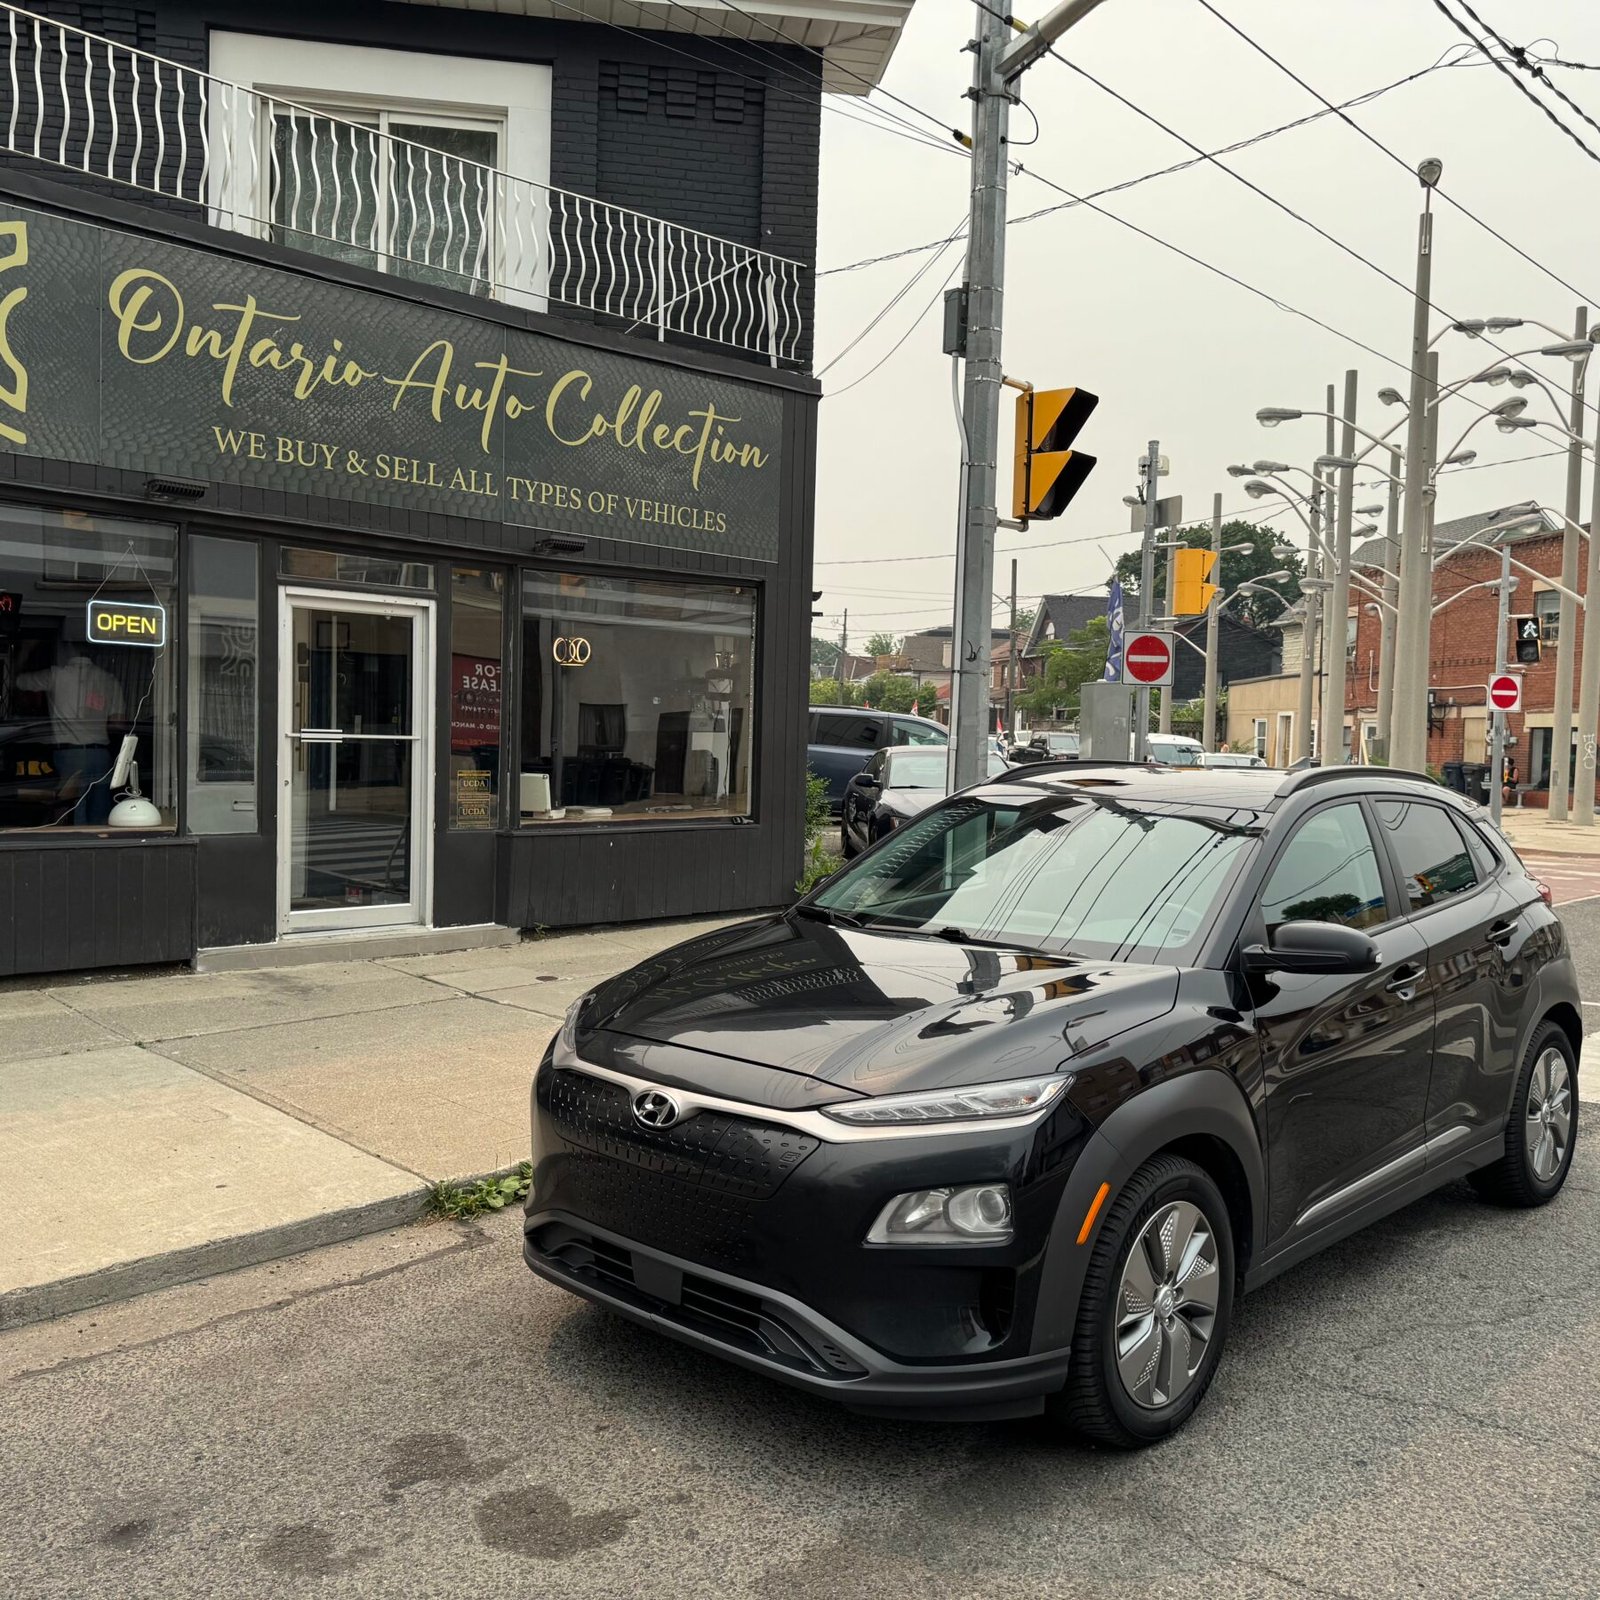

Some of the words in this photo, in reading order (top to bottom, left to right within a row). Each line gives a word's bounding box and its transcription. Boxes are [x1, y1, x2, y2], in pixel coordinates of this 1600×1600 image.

[108, 268, 378, 408] Ontario
[382, 339, 543, 454] Auto
[545, 369, 769, 491] Collection
[211, 425, 267, 460] WE
[275, 436, 340, 470] BUY
[346, 449, 368, 476] &
[375, 454, 443, 487] SELL
[449, 467, 499, 497] ALL
[506, 476, 582, 510] TYPES
[588, 491, 619, 516] OF
[624, 496, 727, 533] VEHICLES
[97, 613, 156, 634] OPEN
[462, 808, 486, 816] UCDA
